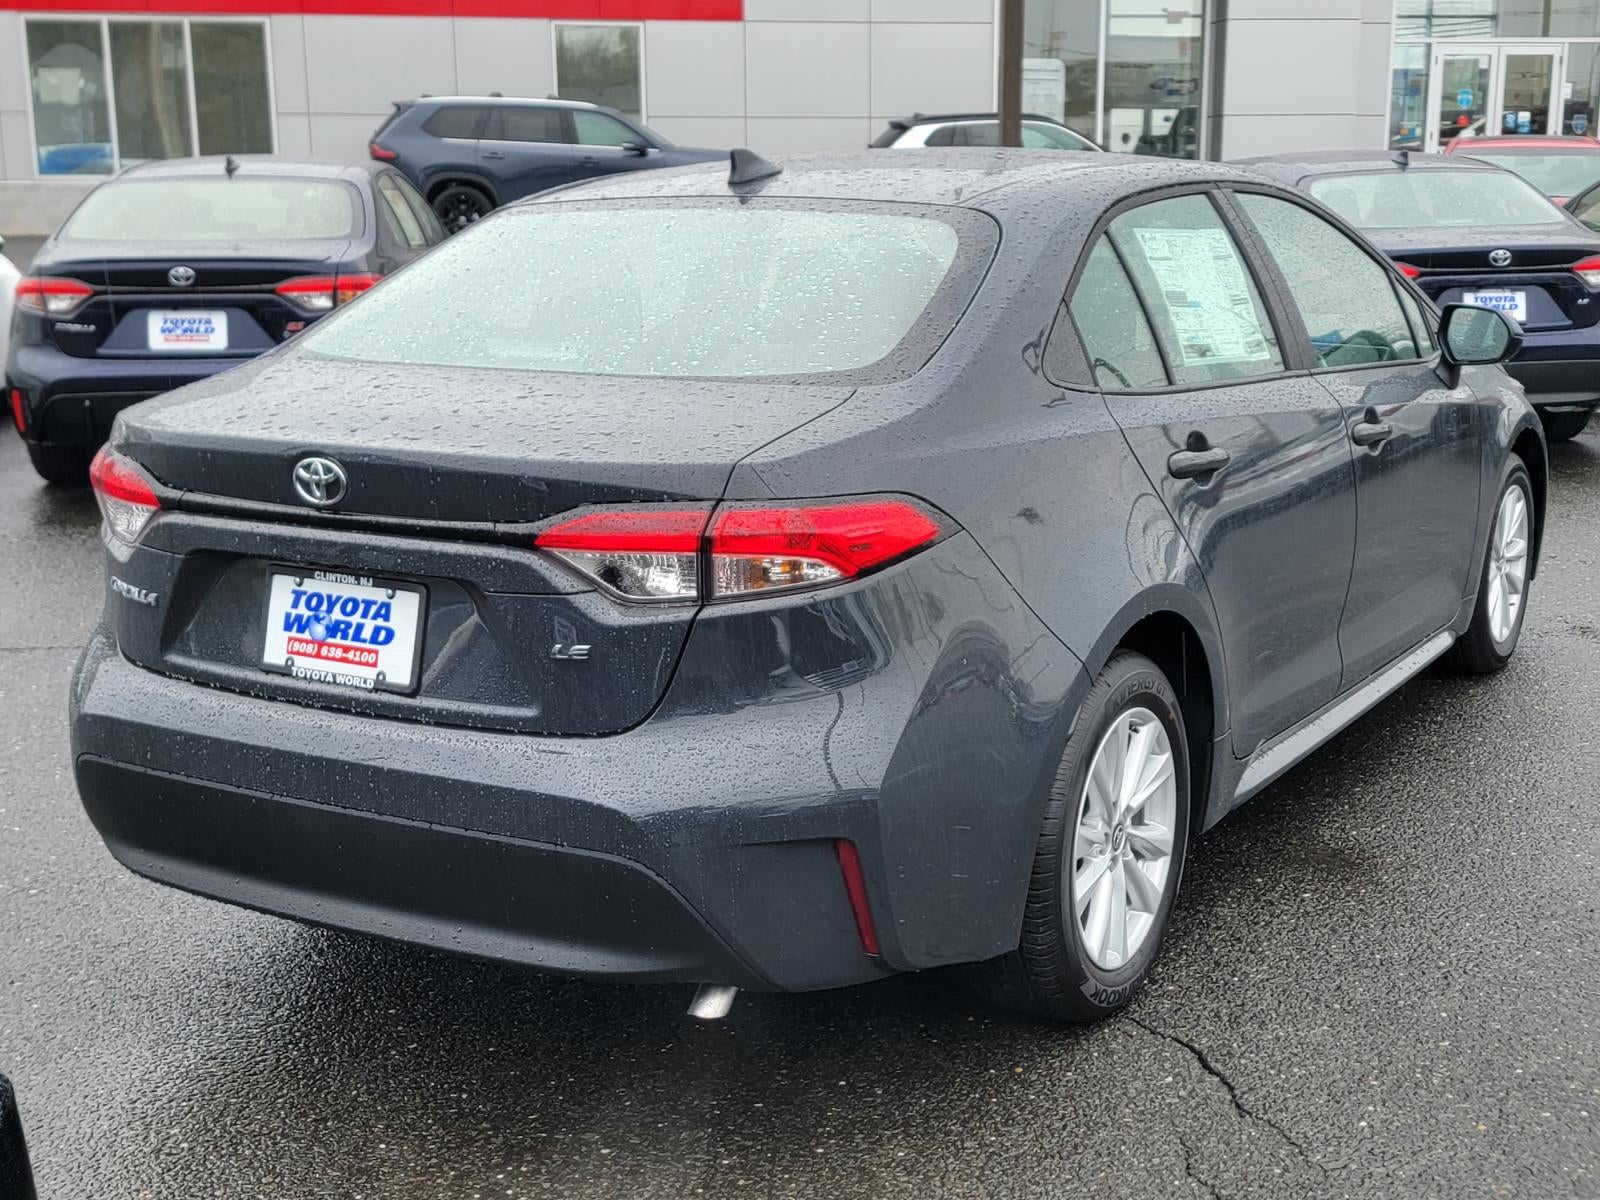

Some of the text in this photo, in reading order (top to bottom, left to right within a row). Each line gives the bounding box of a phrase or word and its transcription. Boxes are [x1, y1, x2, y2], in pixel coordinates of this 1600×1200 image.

[1474, 295, 1516, 303] TOYOTA
[163, 317, 212, 325] TOYOTA
[360, 576, 373, 587] NJ
[291, 589, 391, 622] TOYOTA
[283, 612, 395, 646] WORLD
[288, 640, 376, 663] (908) 638-4100
[550, 644, 592, 659] LE
[291, 667, 374, 689] TOYOTA WORLD
